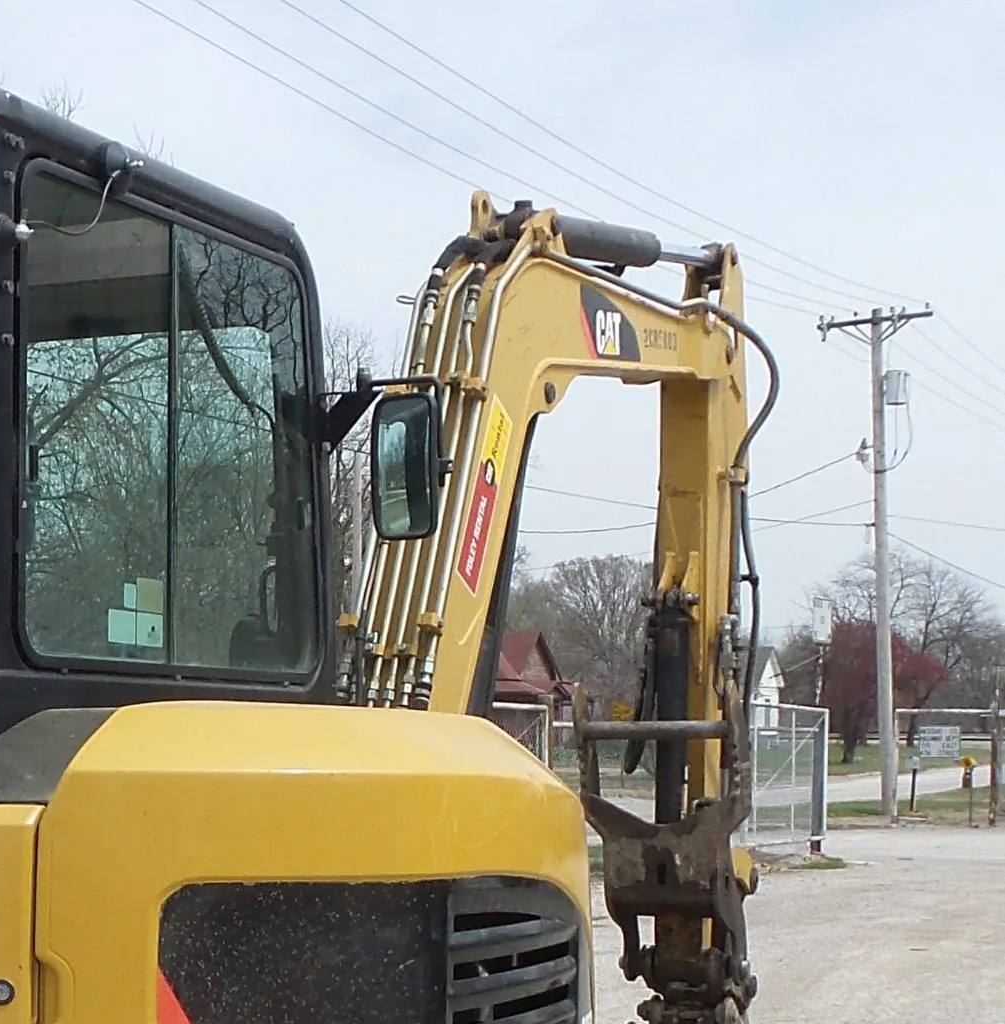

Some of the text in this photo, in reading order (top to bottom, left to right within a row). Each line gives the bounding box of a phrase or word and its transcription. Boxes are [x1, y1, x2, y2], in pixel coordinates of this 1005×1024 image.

[596, 309, 621, 355] CAT
[491, 412, 505, 458] Rental
[465, 495, 488, 577] FOLEY RENTAL
